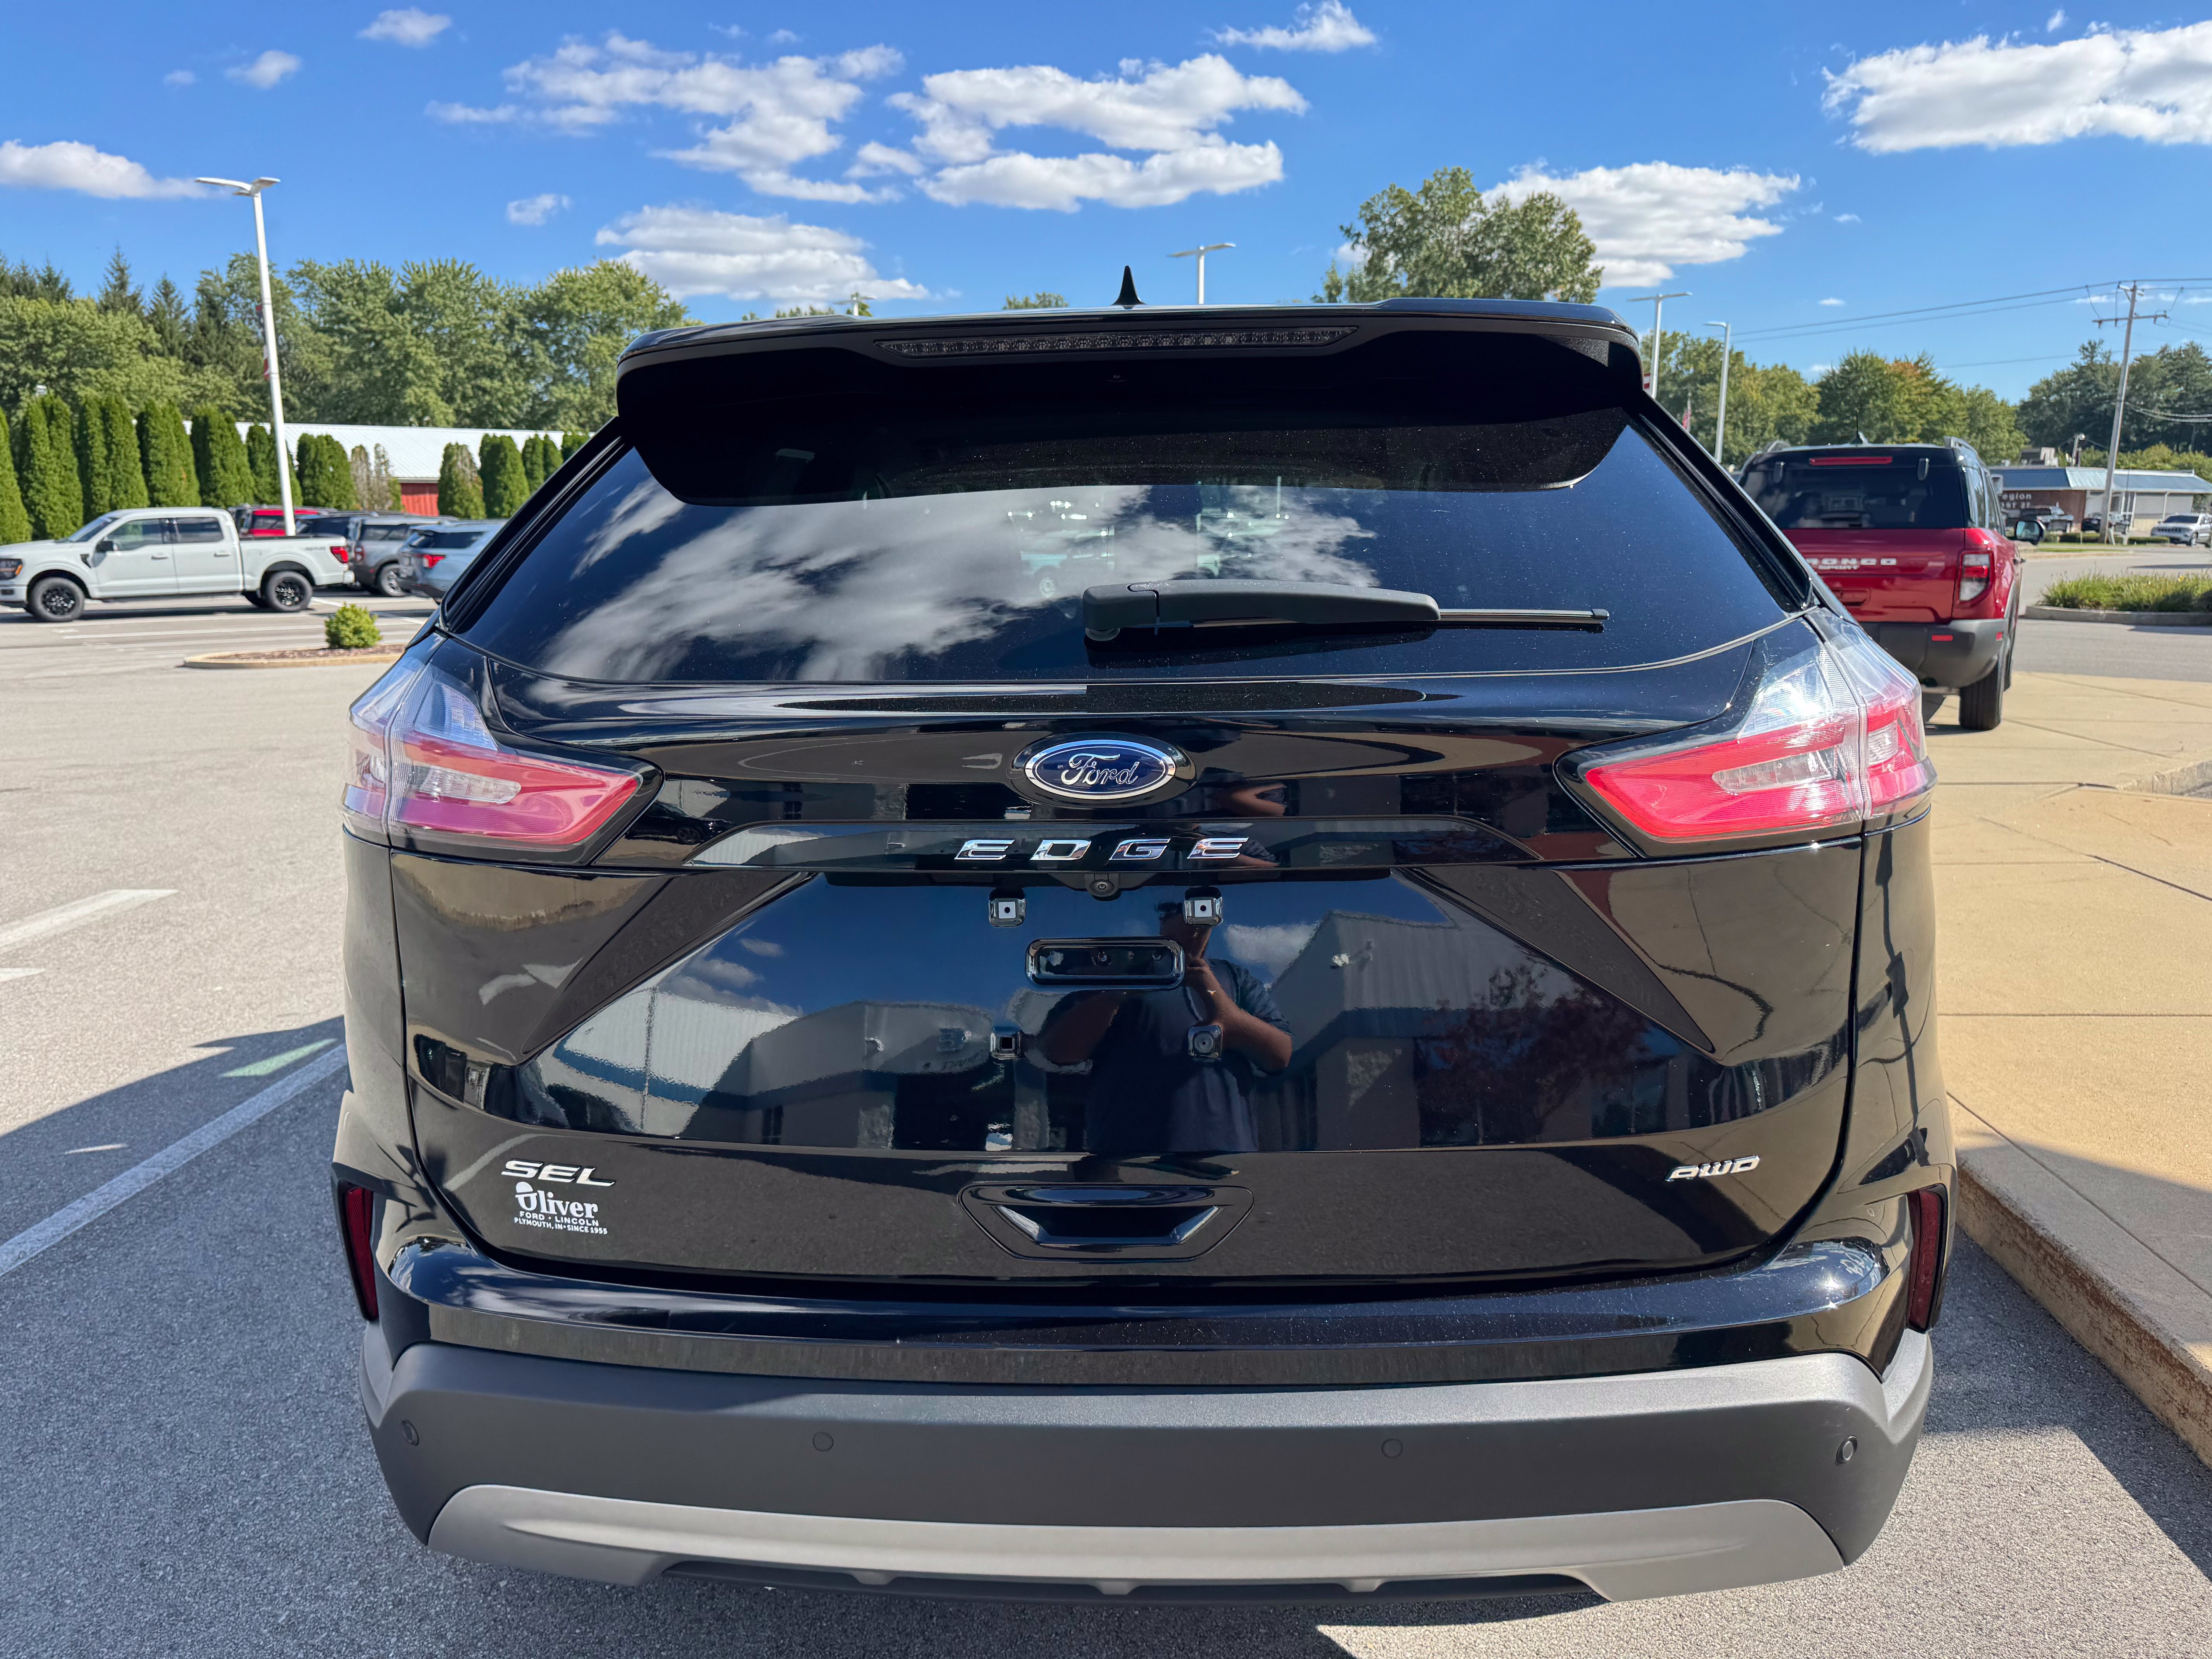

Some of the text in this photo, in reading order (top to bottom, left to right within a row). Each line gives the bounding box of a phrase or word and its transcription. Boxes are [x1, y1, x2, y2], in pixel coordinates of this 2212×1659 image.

[2002, 492, 2032, 501] egion
[1806, 558, 1897, 566] RONCO
[1060, 752, 1140, 786] Ford
[953, 836, 1250, 861] EDGE
[501, 1158, 617, 1187] SEL
[1663, 1154, 1761, 1182] AWD
[515, 1181, 599, 1219] Oliver
[514, 1217, 554, 1230] PLYMOUTH,
[590, 1226, 608, 1235] 1955
[519, 1211, 599, 1227] FORD LINCOLN
